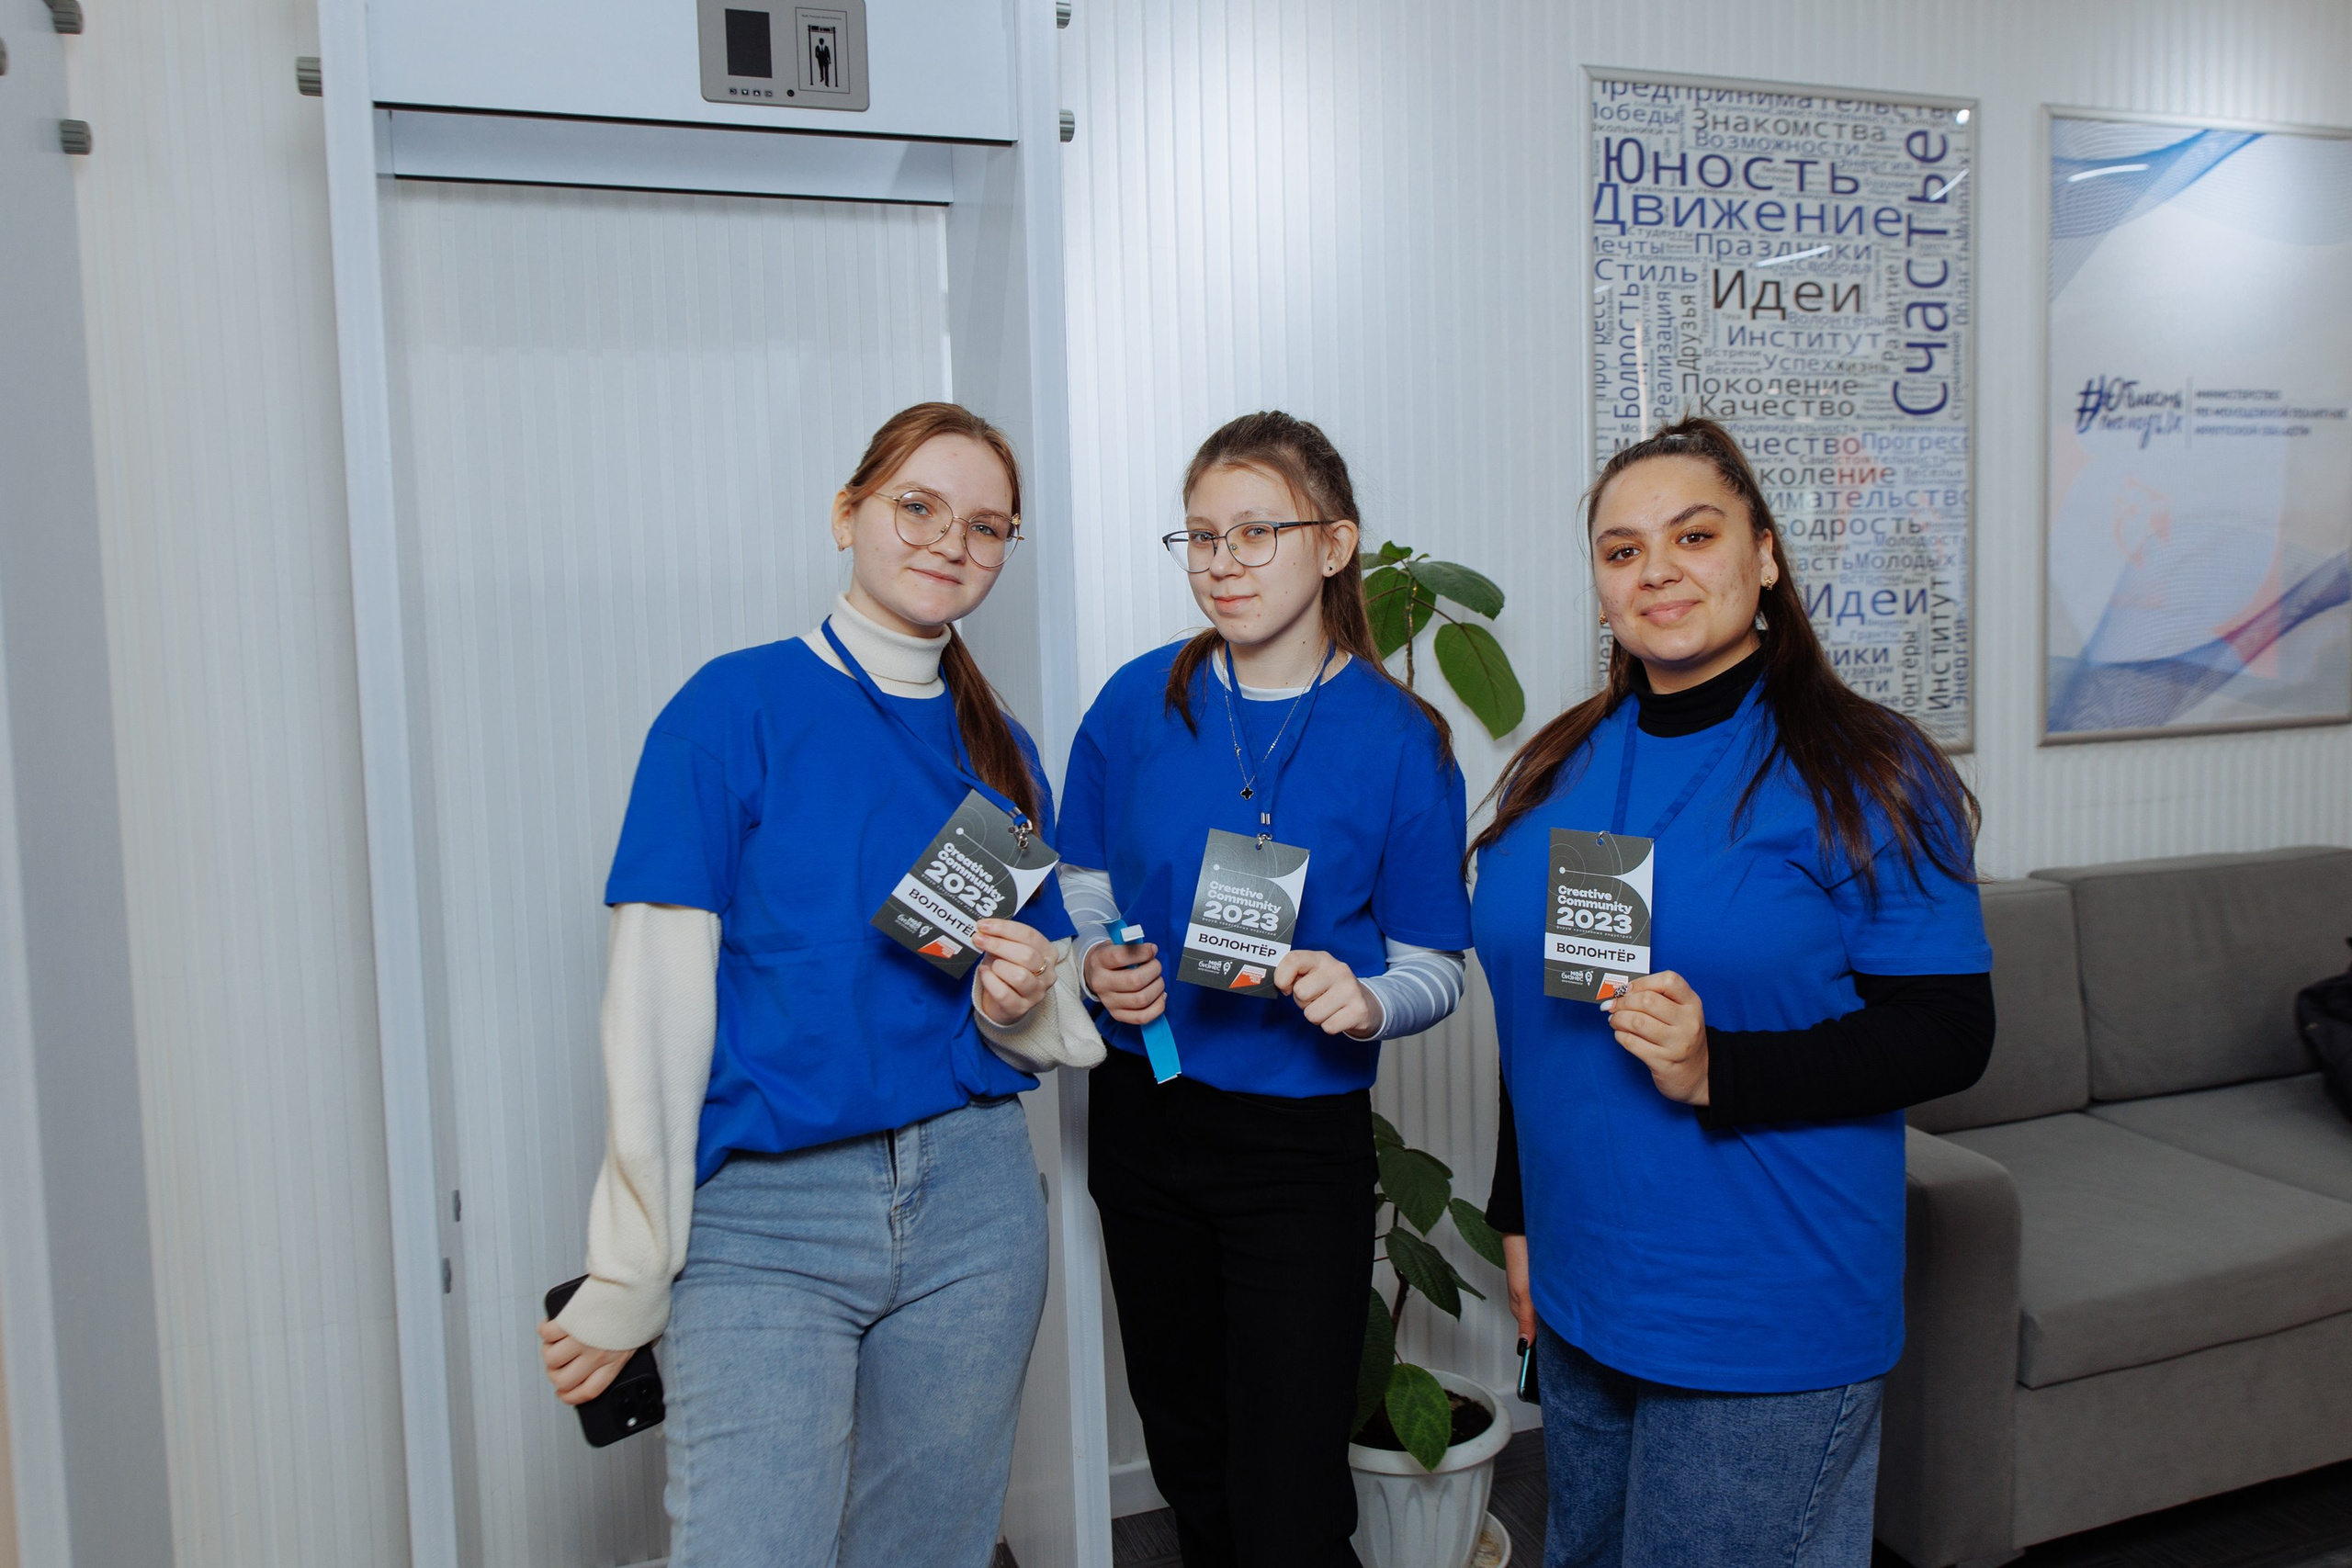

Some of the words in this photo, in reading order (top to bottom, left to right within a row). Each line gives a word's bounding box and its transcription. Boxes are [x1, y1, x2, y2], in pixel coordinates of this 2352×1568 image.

[1692, 107, 1886, 142] Знакомства
[1695, 130, 1860, 156] Возможности
[1605, 136, 1860, 194] Юность
[1594, 182, 1902, 236] Движение
[1696, 232, 1872, 261] Праздники
[1595, 258, 1698, 283] Стиль
[1796, 260, 1872, 276] Свобода
[1893, 130, 1949, 416] Счастье
[1713, 268, 1860, 321] Идеи
[1883, 264, 1902, 361] Развитие
[1677, 295, 1702, 371] Друзья
[1728, 324, 1883, 356] Институт
[1614, 283, 1648, 418] Бодрость
[1654, 291, 1676, 417] Реализация
[1704, 347, 1762, 360] Встречи
[1764, 354, 1837, 371] Успех
[1682, 373, 1858, 395] Поколение
[1705, 366, 1763, 376] Веселье
[1701, 395, 1855, 416] Качество
[1760, 466, 1896, 485] коление
[1854, 553, 1955, 571] Молодых
[1805, 583, 1928, 626] Идеи
[1927, 578, 1957, 710] Институт
[937, 850, 1006, 902] Community
[944, 842, 993, 883] Creative
[923, 860, 998, 917] 2023
[1206, 889, 1282, 914] Community
[1209, 880, 1263, 900] Creative
[1557, 885, 1612, 900] Creative
[1203, 901, 1279, 931] 2023
[1557, 895, 1633, 914] Community
[1556, 907, 1633, 934] 2023
[1198, 933, 1277, 957] ВОЛОНТЁР
[1556, 942, 1636, 963] ВОЛОНТЁР
[1561, 972, 1584, 982] бизнес
